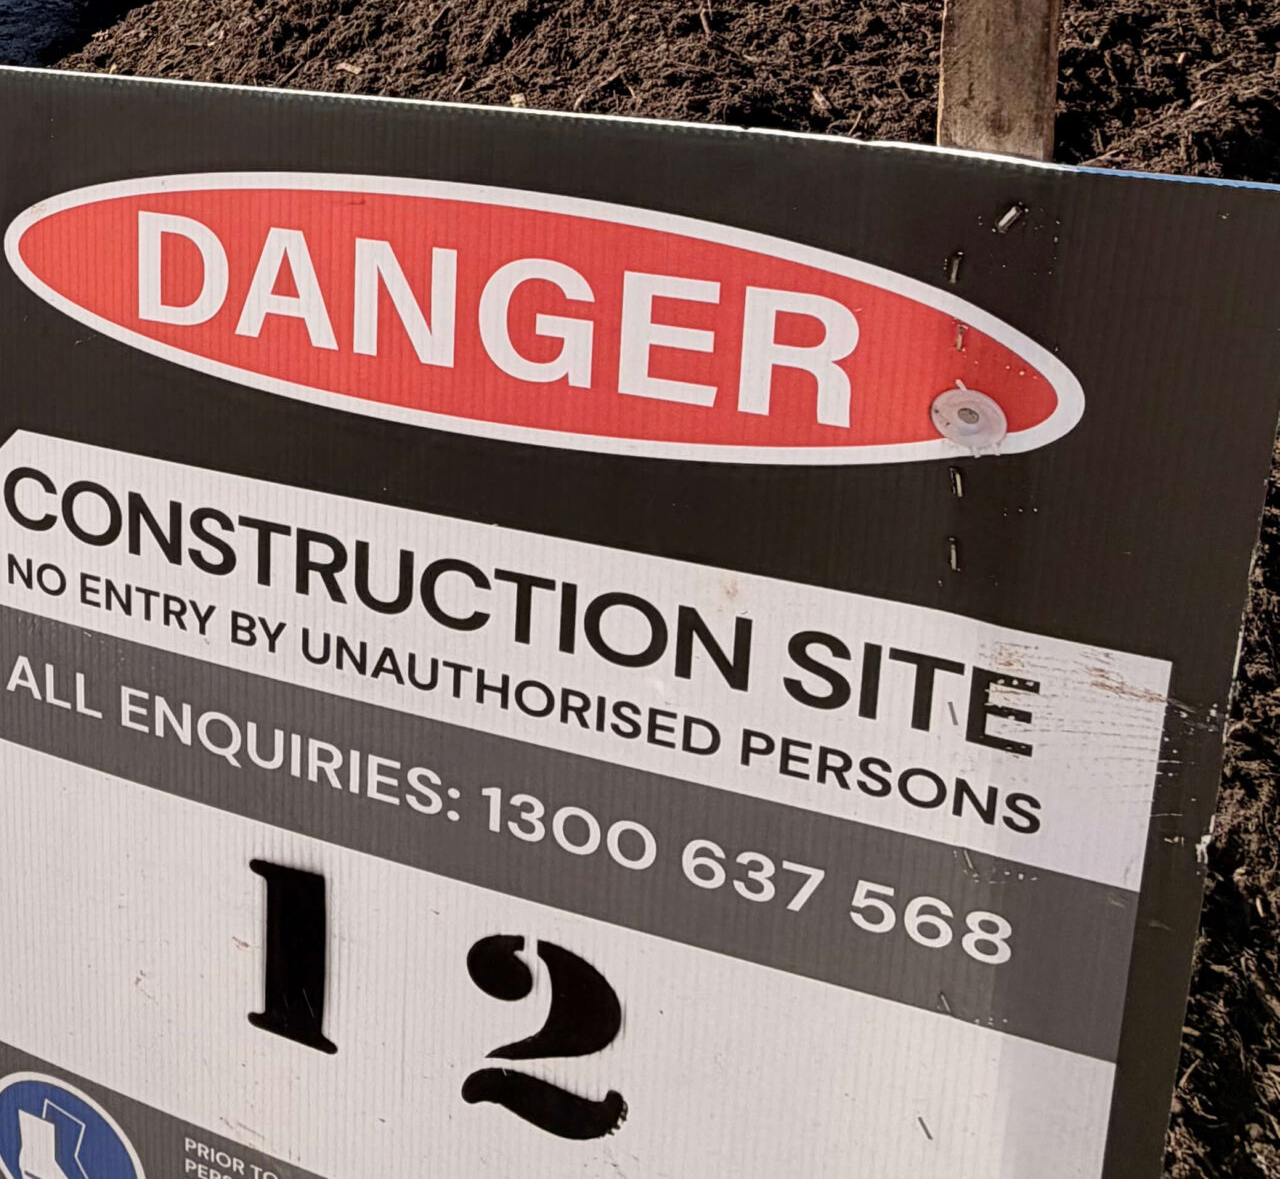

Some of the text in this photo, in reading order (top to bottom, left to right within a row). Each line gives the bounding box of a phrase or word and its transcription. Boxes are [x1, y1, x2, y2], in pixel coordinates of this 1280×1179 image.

[136, 209, 860, 428] DANGER
[3, 466, 1041, 758] CONSTRUCTION SITE
[6, 553, 1043, 835] NO ENTRY BY UNAUTHORISED PERSONS
[6, 654, 1014, 966] ALL ENQUIRIES: 1300 637 568
[184, 1136, 246, 1176] PRIOR
